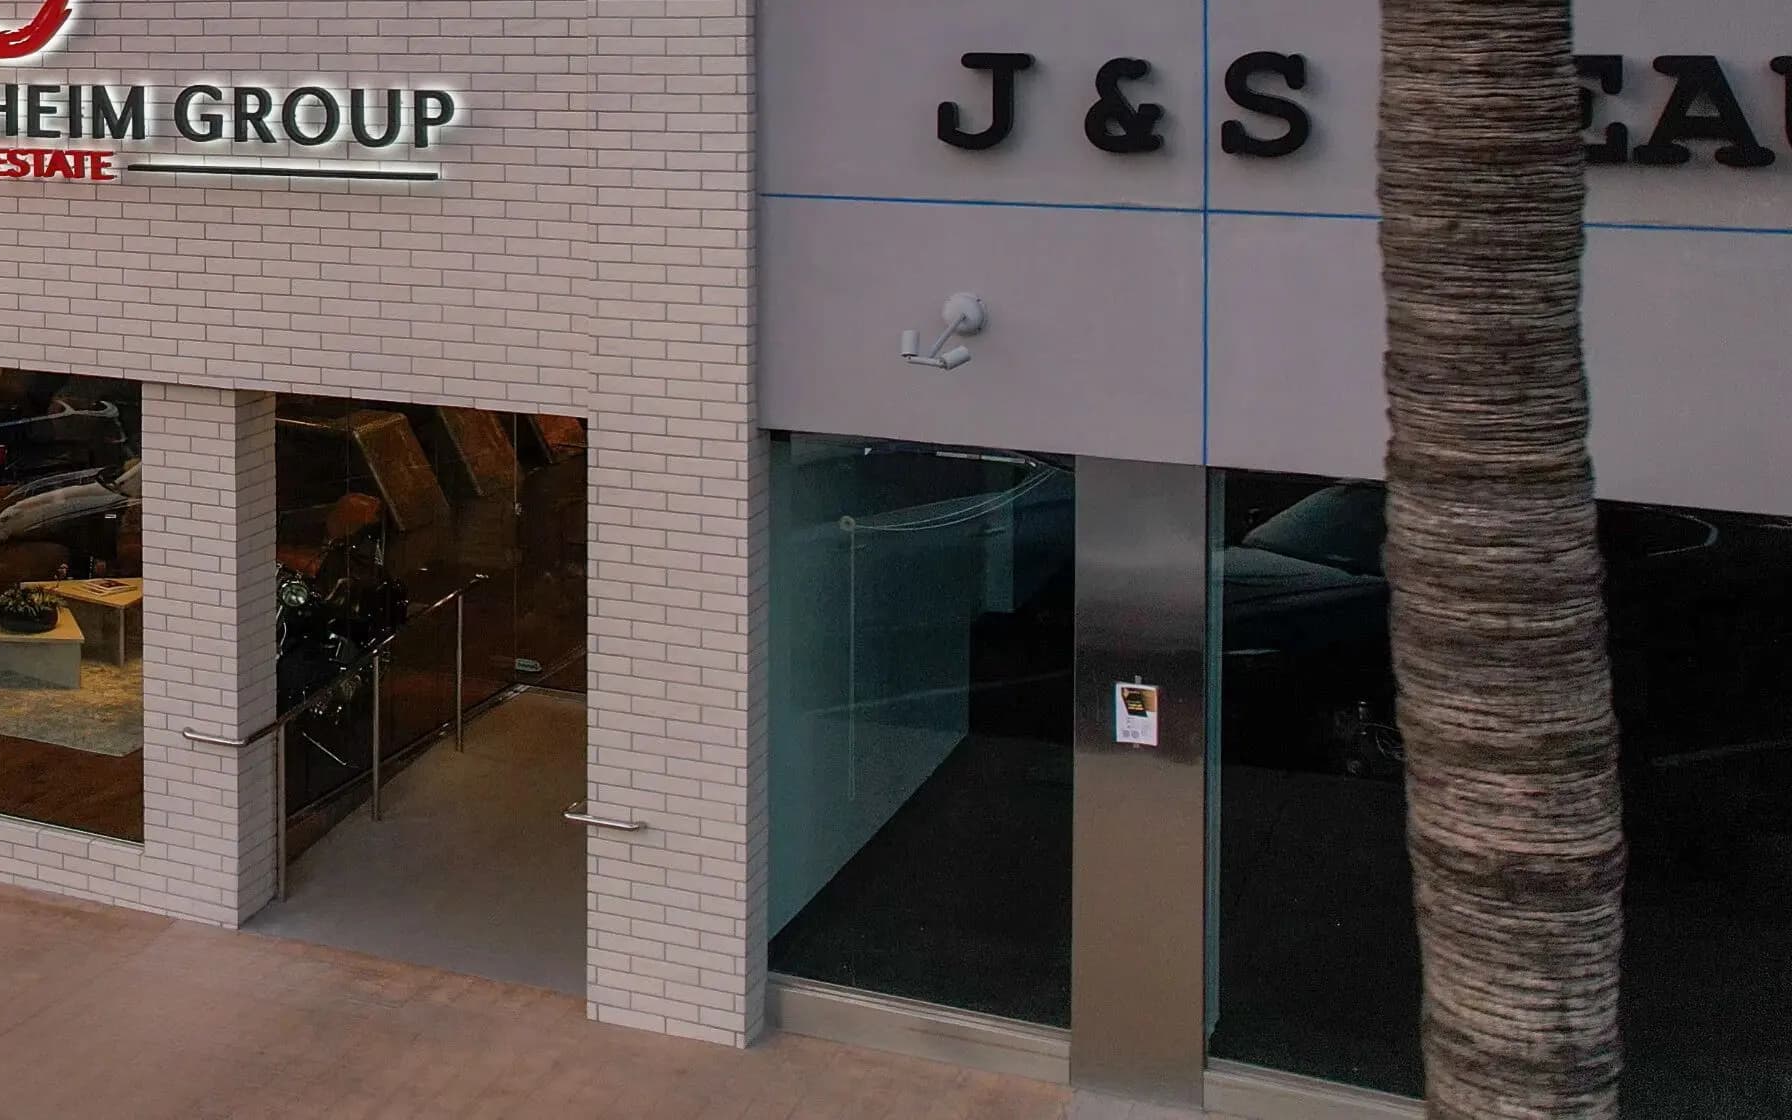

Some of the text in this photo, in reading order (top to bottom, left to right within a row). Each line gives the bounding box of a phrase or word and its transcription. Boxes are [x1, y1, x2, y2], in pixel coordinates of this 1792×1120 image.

[174, 84, 455, 149] GROUP
[937, 52, 1036, 151] J
[1084, 57, 1164, 153] &
[1221, 51, 1312, 158] S
